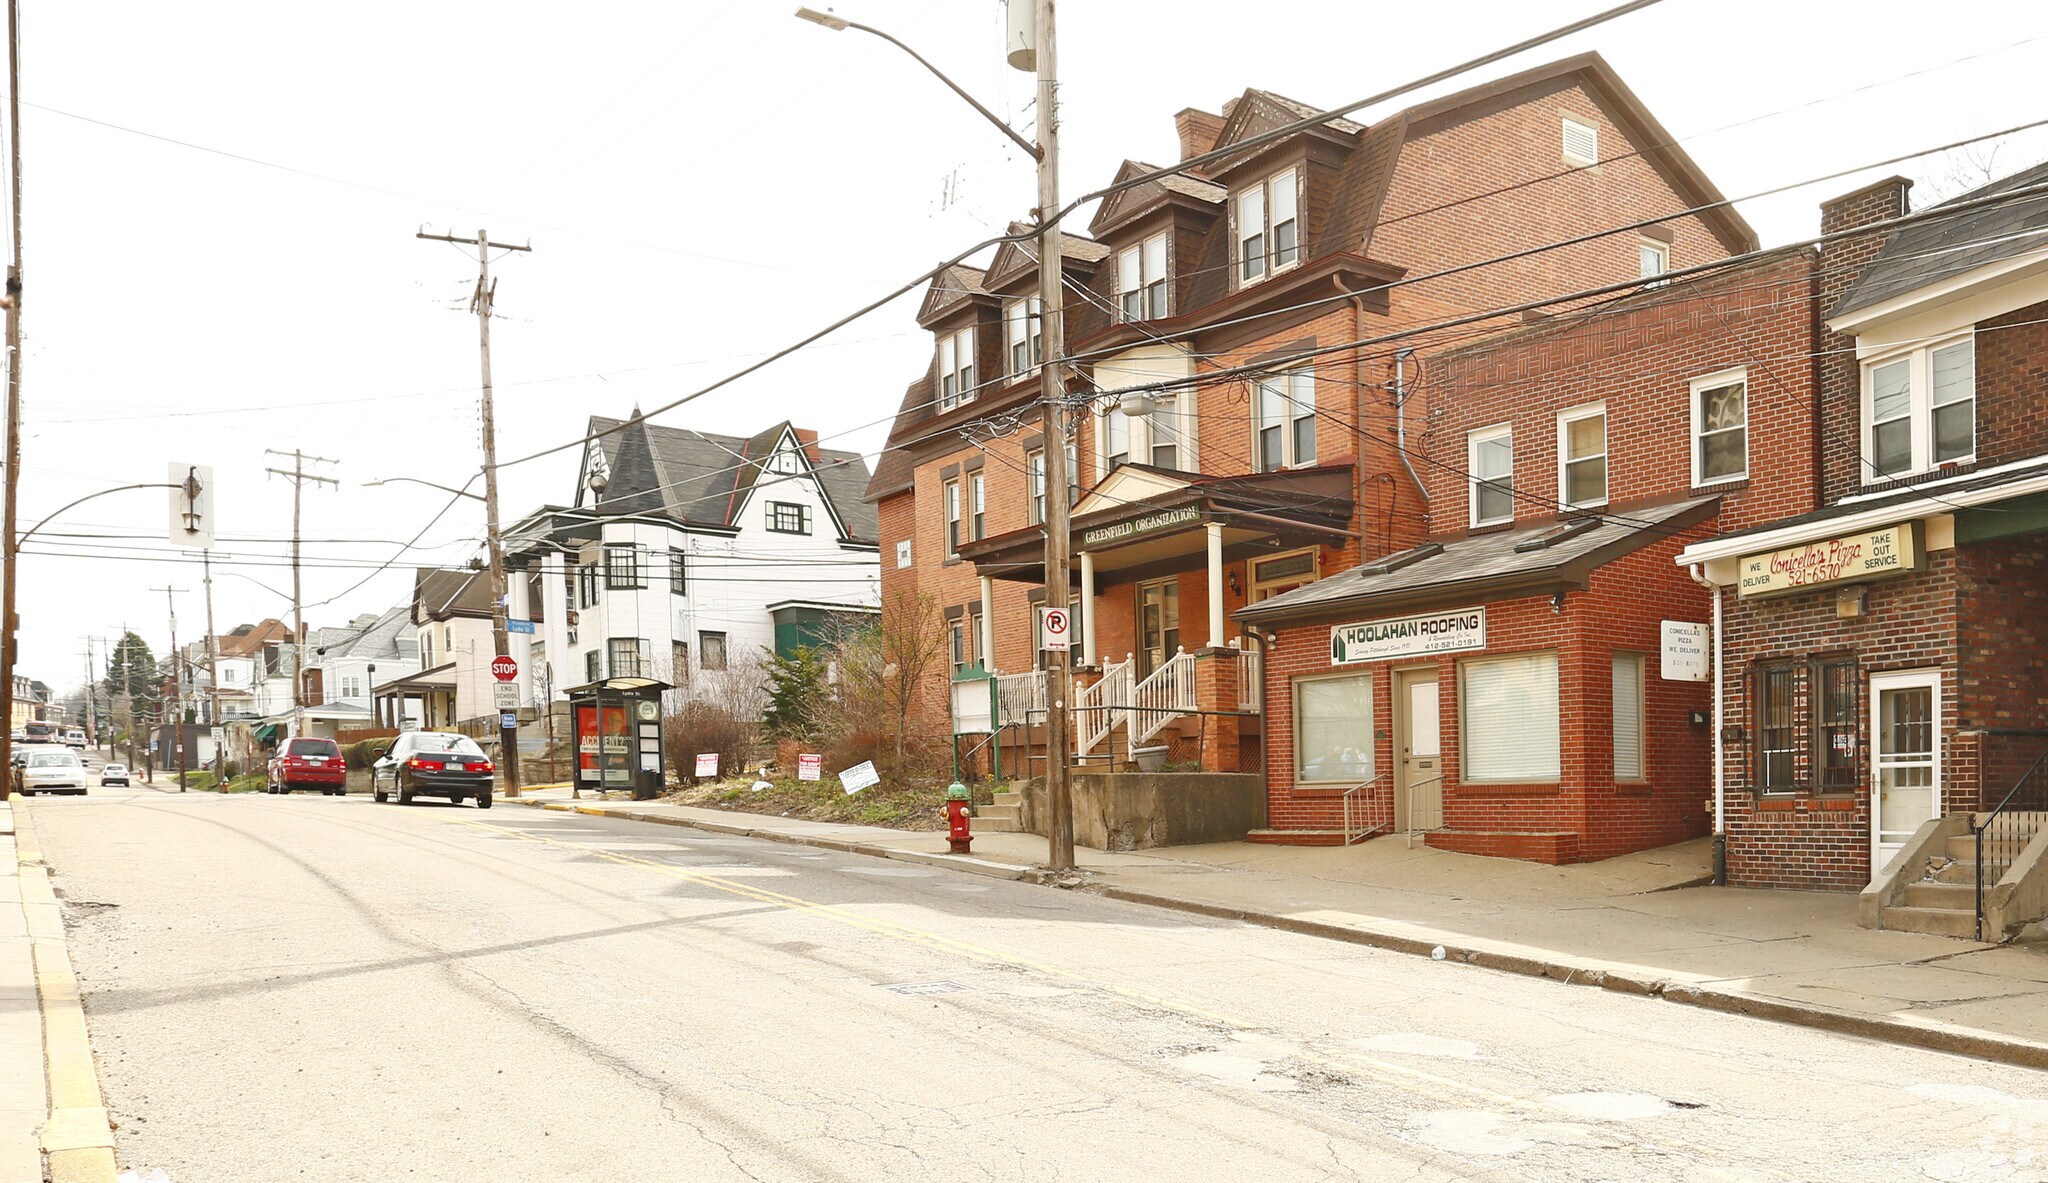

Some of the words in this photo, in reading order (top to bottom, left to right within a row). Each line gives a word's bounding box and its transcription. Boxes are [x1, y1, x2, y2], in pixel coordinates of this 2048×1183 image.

[1085, 522, 1133, 543] GREENFIELD
[1135, 505, 1195, 532] ORGANIZATION
[1870, 533, 1891, 546] TAKE
[1770, 544, 1826, 575] Conicella's
[1828, 540, 1862, 568] Pizza
[1873, 545, 1891, 557] OUT
[1750, 562, 1761, 572] WE
[1864, 554, 1898, 570] SERVICE
[1788, 562, 1841, 587] 521-6570
[1743, 575, 1770, 588] DELIVER
[1347, 621, 1418, 644] HOOLAHAN
[1420, 615, 1479, 636] ROOFING
[1424, 638, 1478, 650] 412-521-0191
[492, 663, 516, 674] STOP
[582, 735, 625, 746] ACCIENT?
